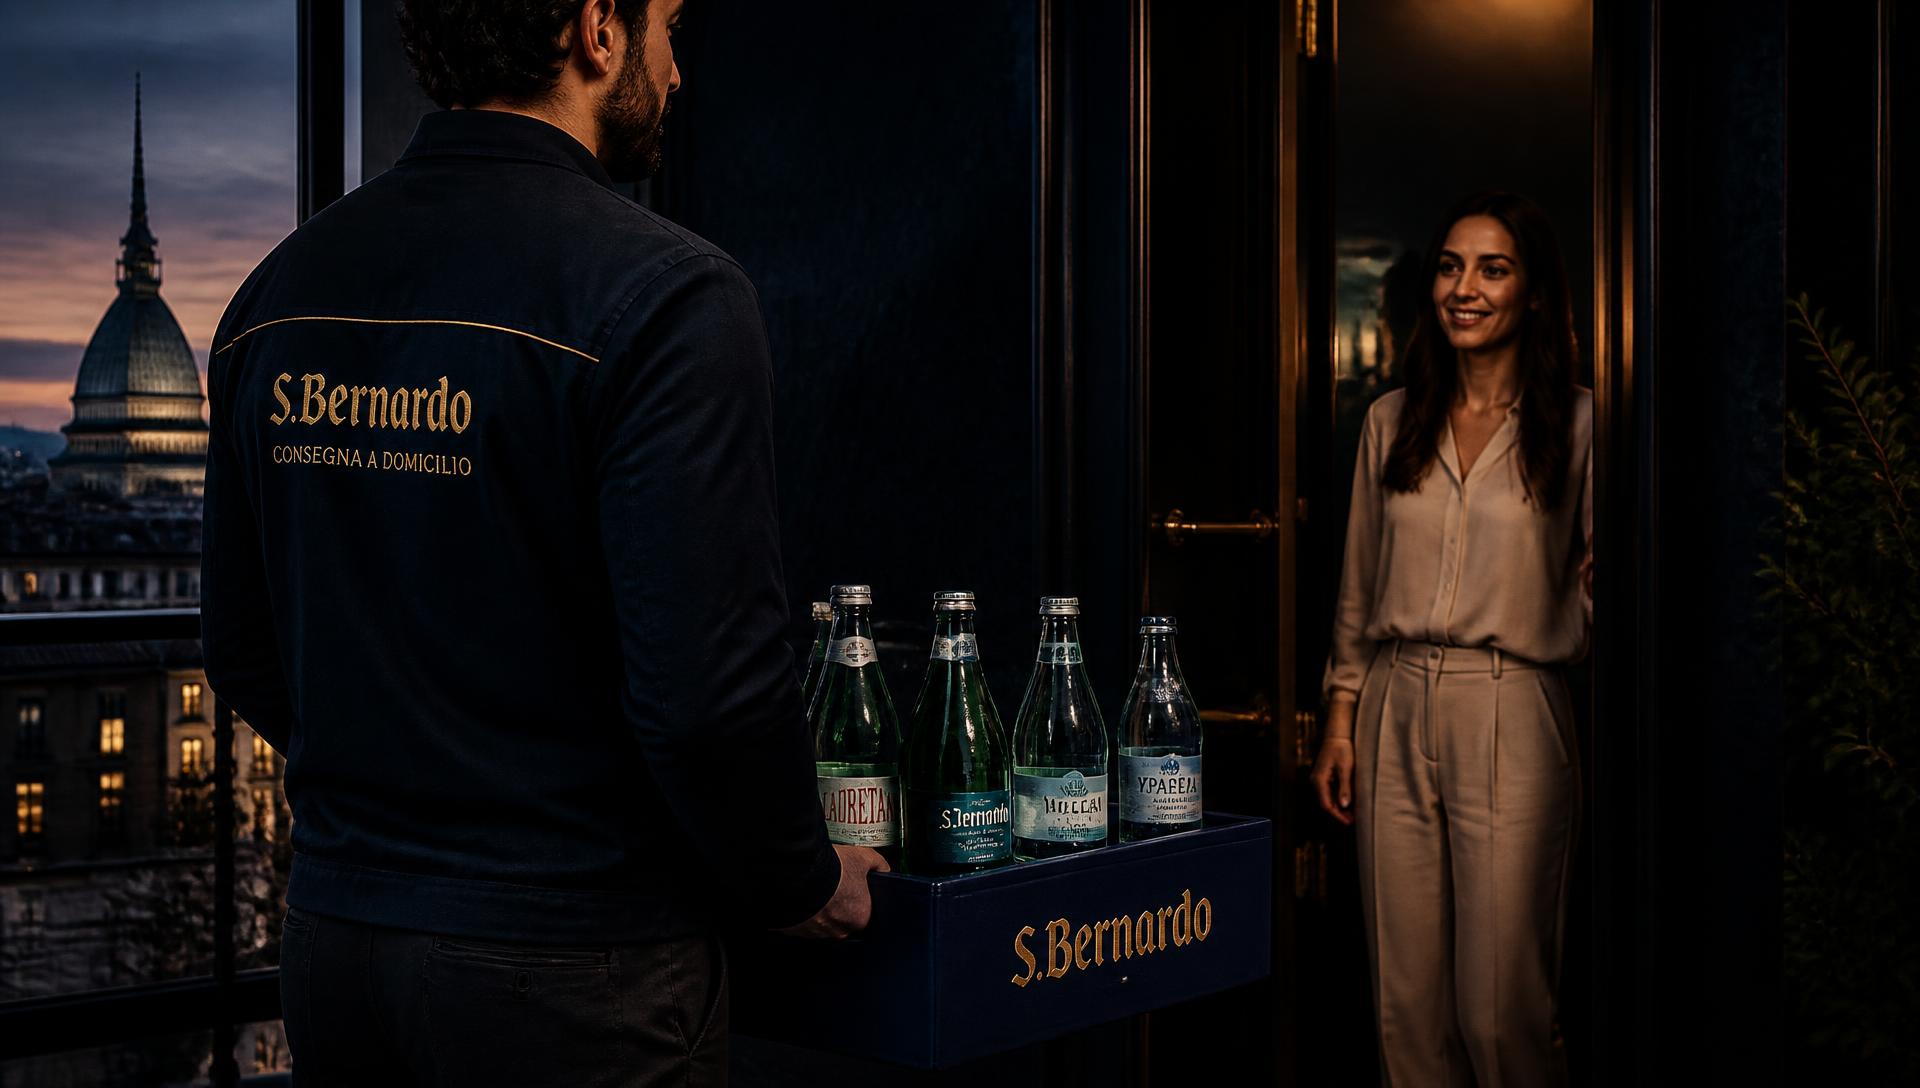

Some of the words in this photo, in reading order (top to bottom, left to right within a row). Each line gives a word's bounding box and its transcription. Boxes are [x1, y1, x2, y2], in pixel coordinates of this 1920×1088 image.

[270, 372, 472, 434] S.Bernardo
[273, 445, 362, 468] CONSEGNA
[367, 450, 378, 469] A
[383, 451, 472, 476] DOMICILIO
[1011, 888, 1212, 988] S.Bernardo
